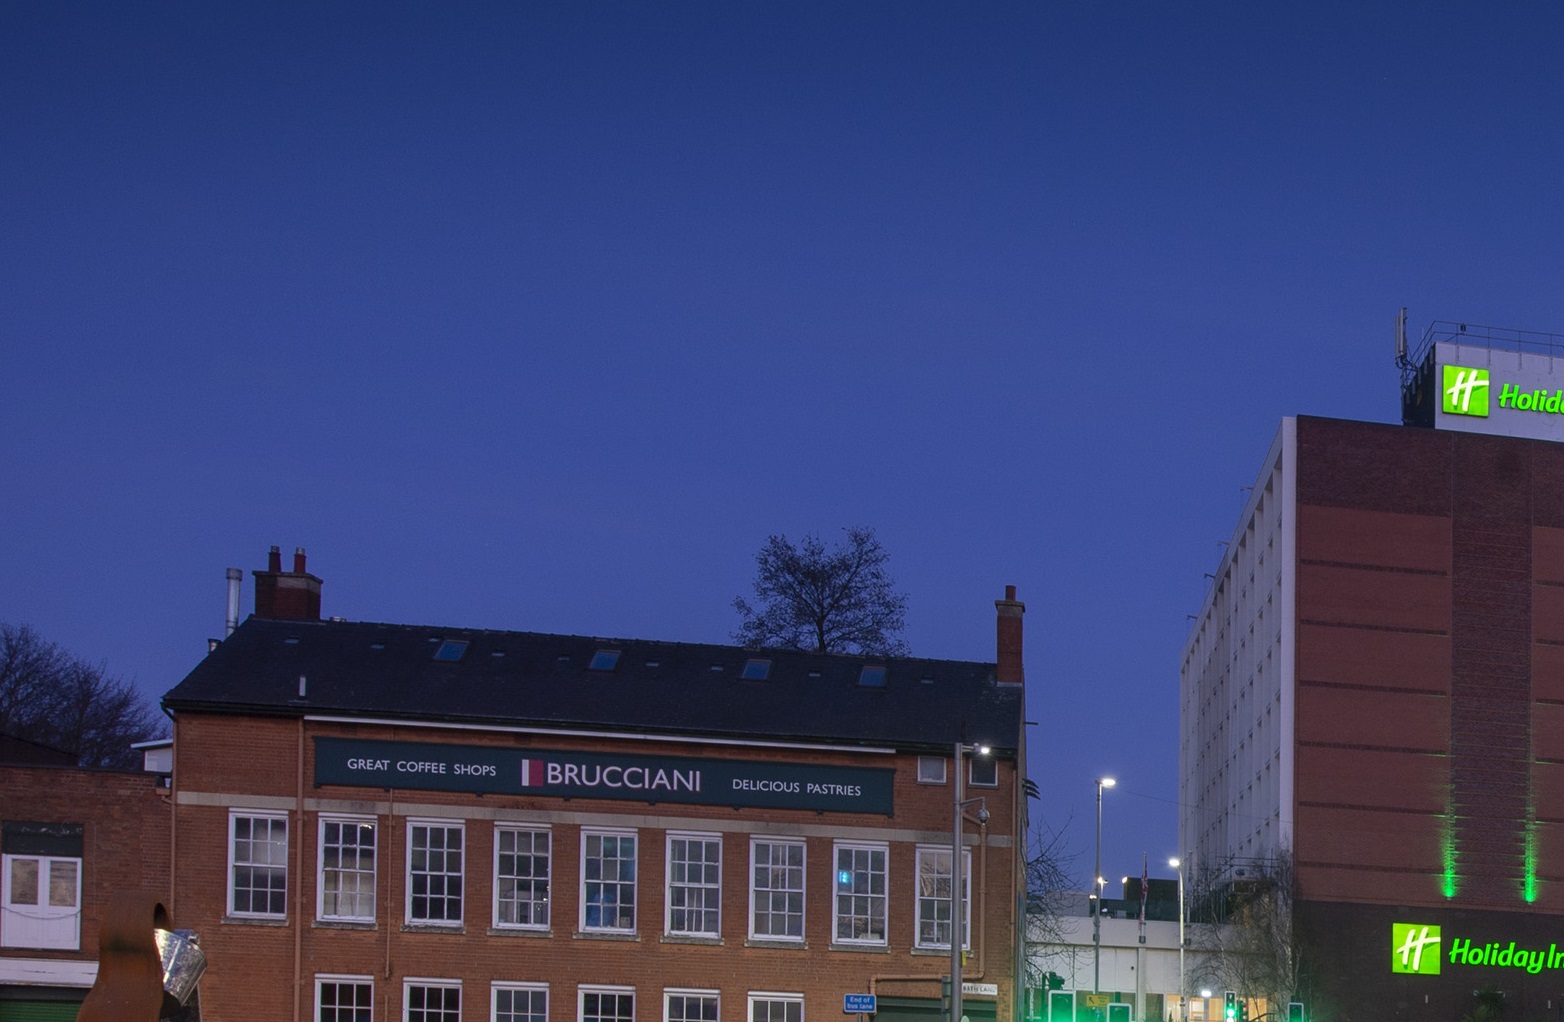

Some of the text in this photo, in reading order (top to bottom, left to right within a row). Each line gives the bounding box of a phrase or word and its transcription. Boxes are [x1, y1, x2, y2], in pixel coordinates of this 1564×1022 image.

[347, 757, 497, 777] GREAT COFFEE SHOPS
[547, 762, 701, 793] BRUCCIANI
[732, 778, 862, 797] DELICIOUS PASTRIES
[1449, 938, 1544, 974] Holiday
